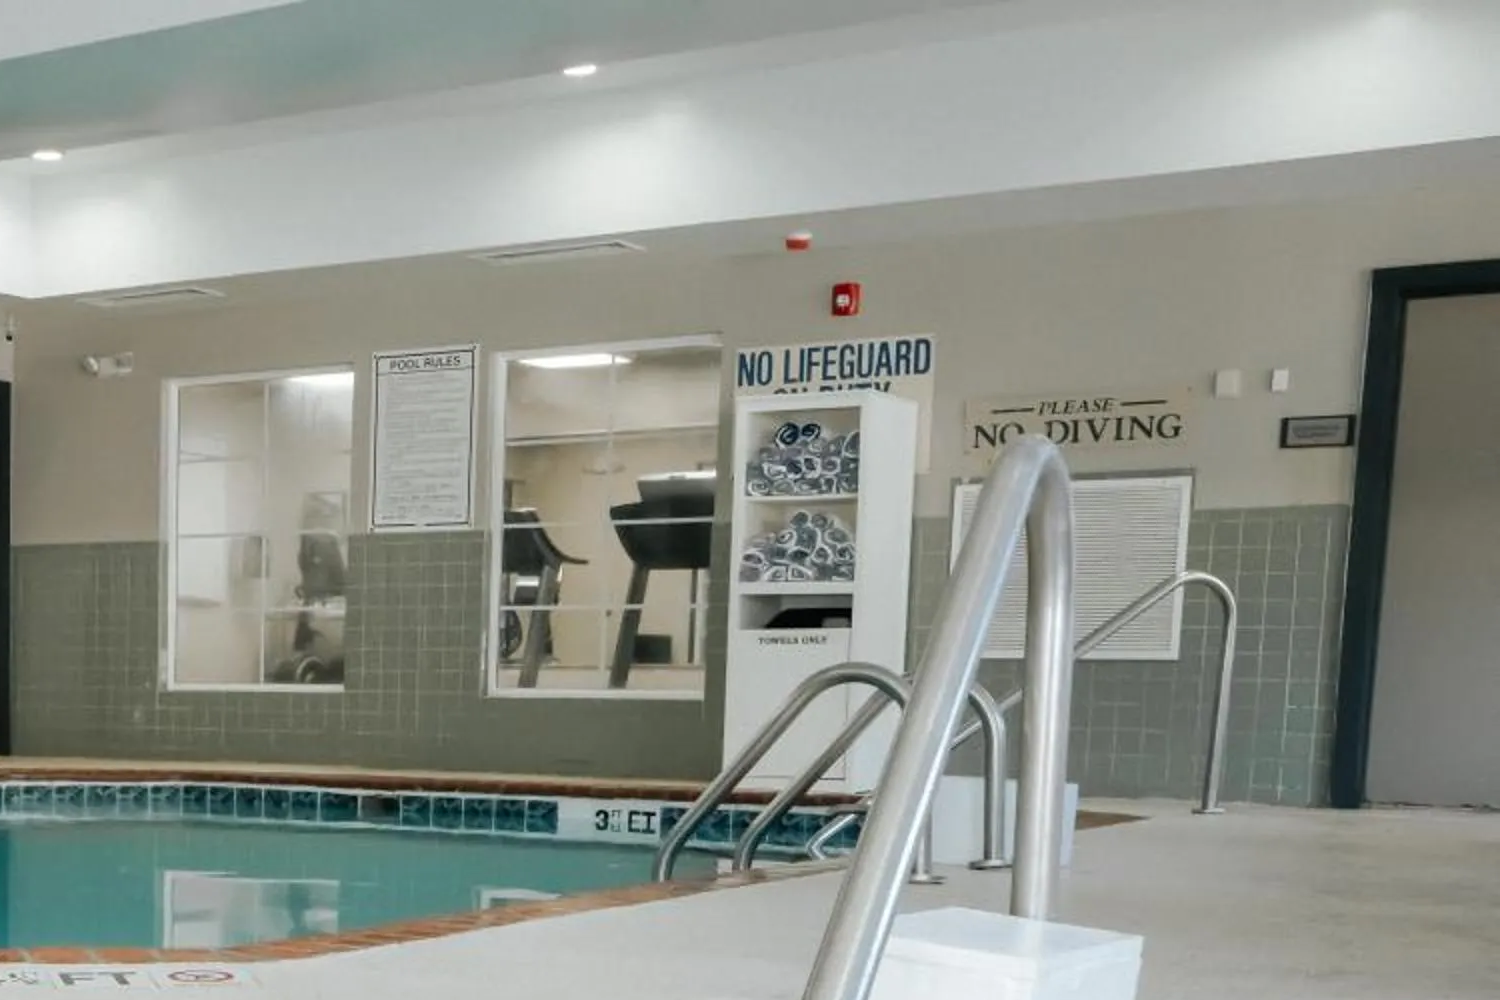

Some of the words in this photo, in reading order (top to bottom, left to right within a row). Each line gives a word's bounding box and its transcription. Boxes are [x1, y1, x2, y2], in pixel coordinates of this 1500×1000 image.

[389, 358, 421, 370] POOL
[424, 355, 461, 368] RULES
[737, 351, 773, 387] NO
[783, 338, 931, 385] LIFEGUARD
[1038, 397, 1118, 416] PLEASE
[1044, 413, 1183, 445] DIVING
[58, 971, 137, 986] FT
